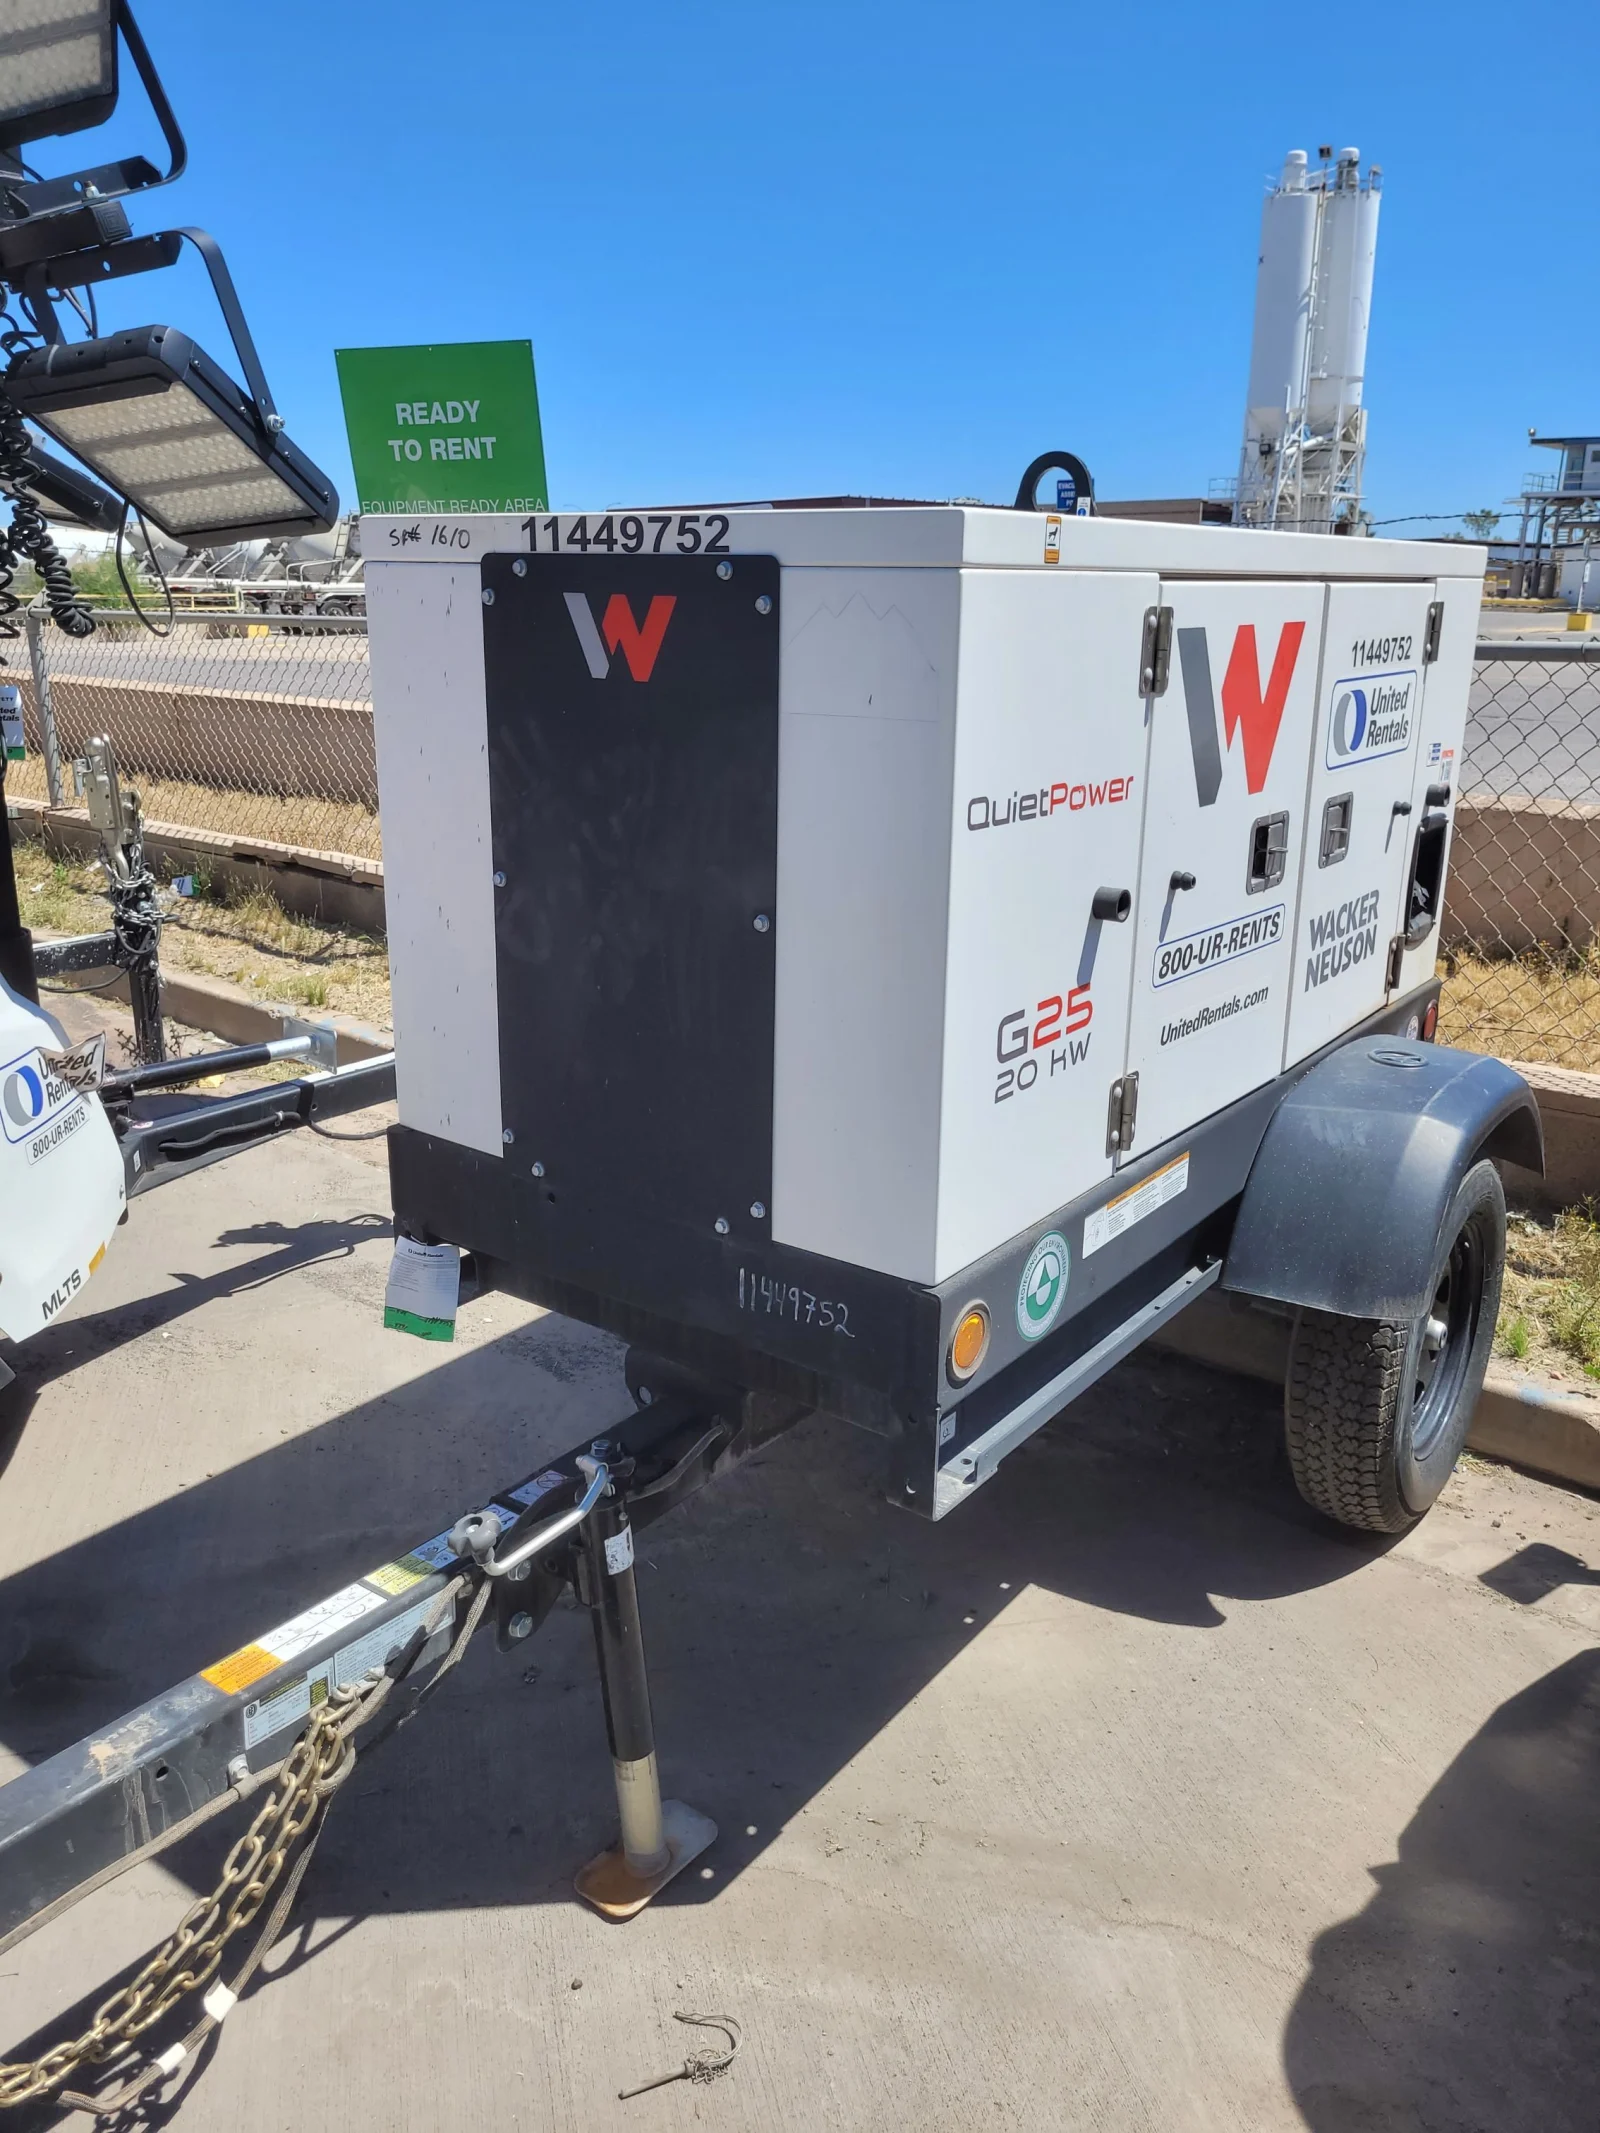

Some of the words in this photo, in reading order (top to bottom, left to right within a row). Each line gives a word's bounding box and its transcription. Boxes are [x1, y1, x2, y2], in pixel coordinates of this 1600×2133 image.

[395, 400, 480, 425] READY
[388, 439, 422, 461] TO
[429, 436, 496, 460] RENT
[362, 500, 445, 514] EQUIPMENT
[450, 499, 499, 513] READY
[504, 498, 545, 512] AREA
[431, 524, 471, 549] 1610
[521, 515, 730, 553] 11449752
[1352, 636, 1412, 667] 11449752
[1370, 682, 1411, 716] United
[1366, 713, 1409, 748] Rentals
[967, 776, 1134, 831] QuietPower
[1309, 889, 1380, 952] WACKER
[1158, 911, 1281, 979] 800-UR-RENTS
[1304, 924, 1378, 993] NEUSON
[997, 981, 1093, 1064] G25
[1160, 986, 1269, 1046] UnitedRentals.com
[38, 1043, 99, 1080] United
[994, 1059, 1038, 1105] 20
[45, 1068, 98, 1108] Rentals
[32, 1106, 86, 1159] 800-UR-RENTS
[42, 1268, 82, 1321] MLTS
[739, 1267, 856, 1338] 11449752
[1020, 1253, 1038, 1307] PROTECTING
